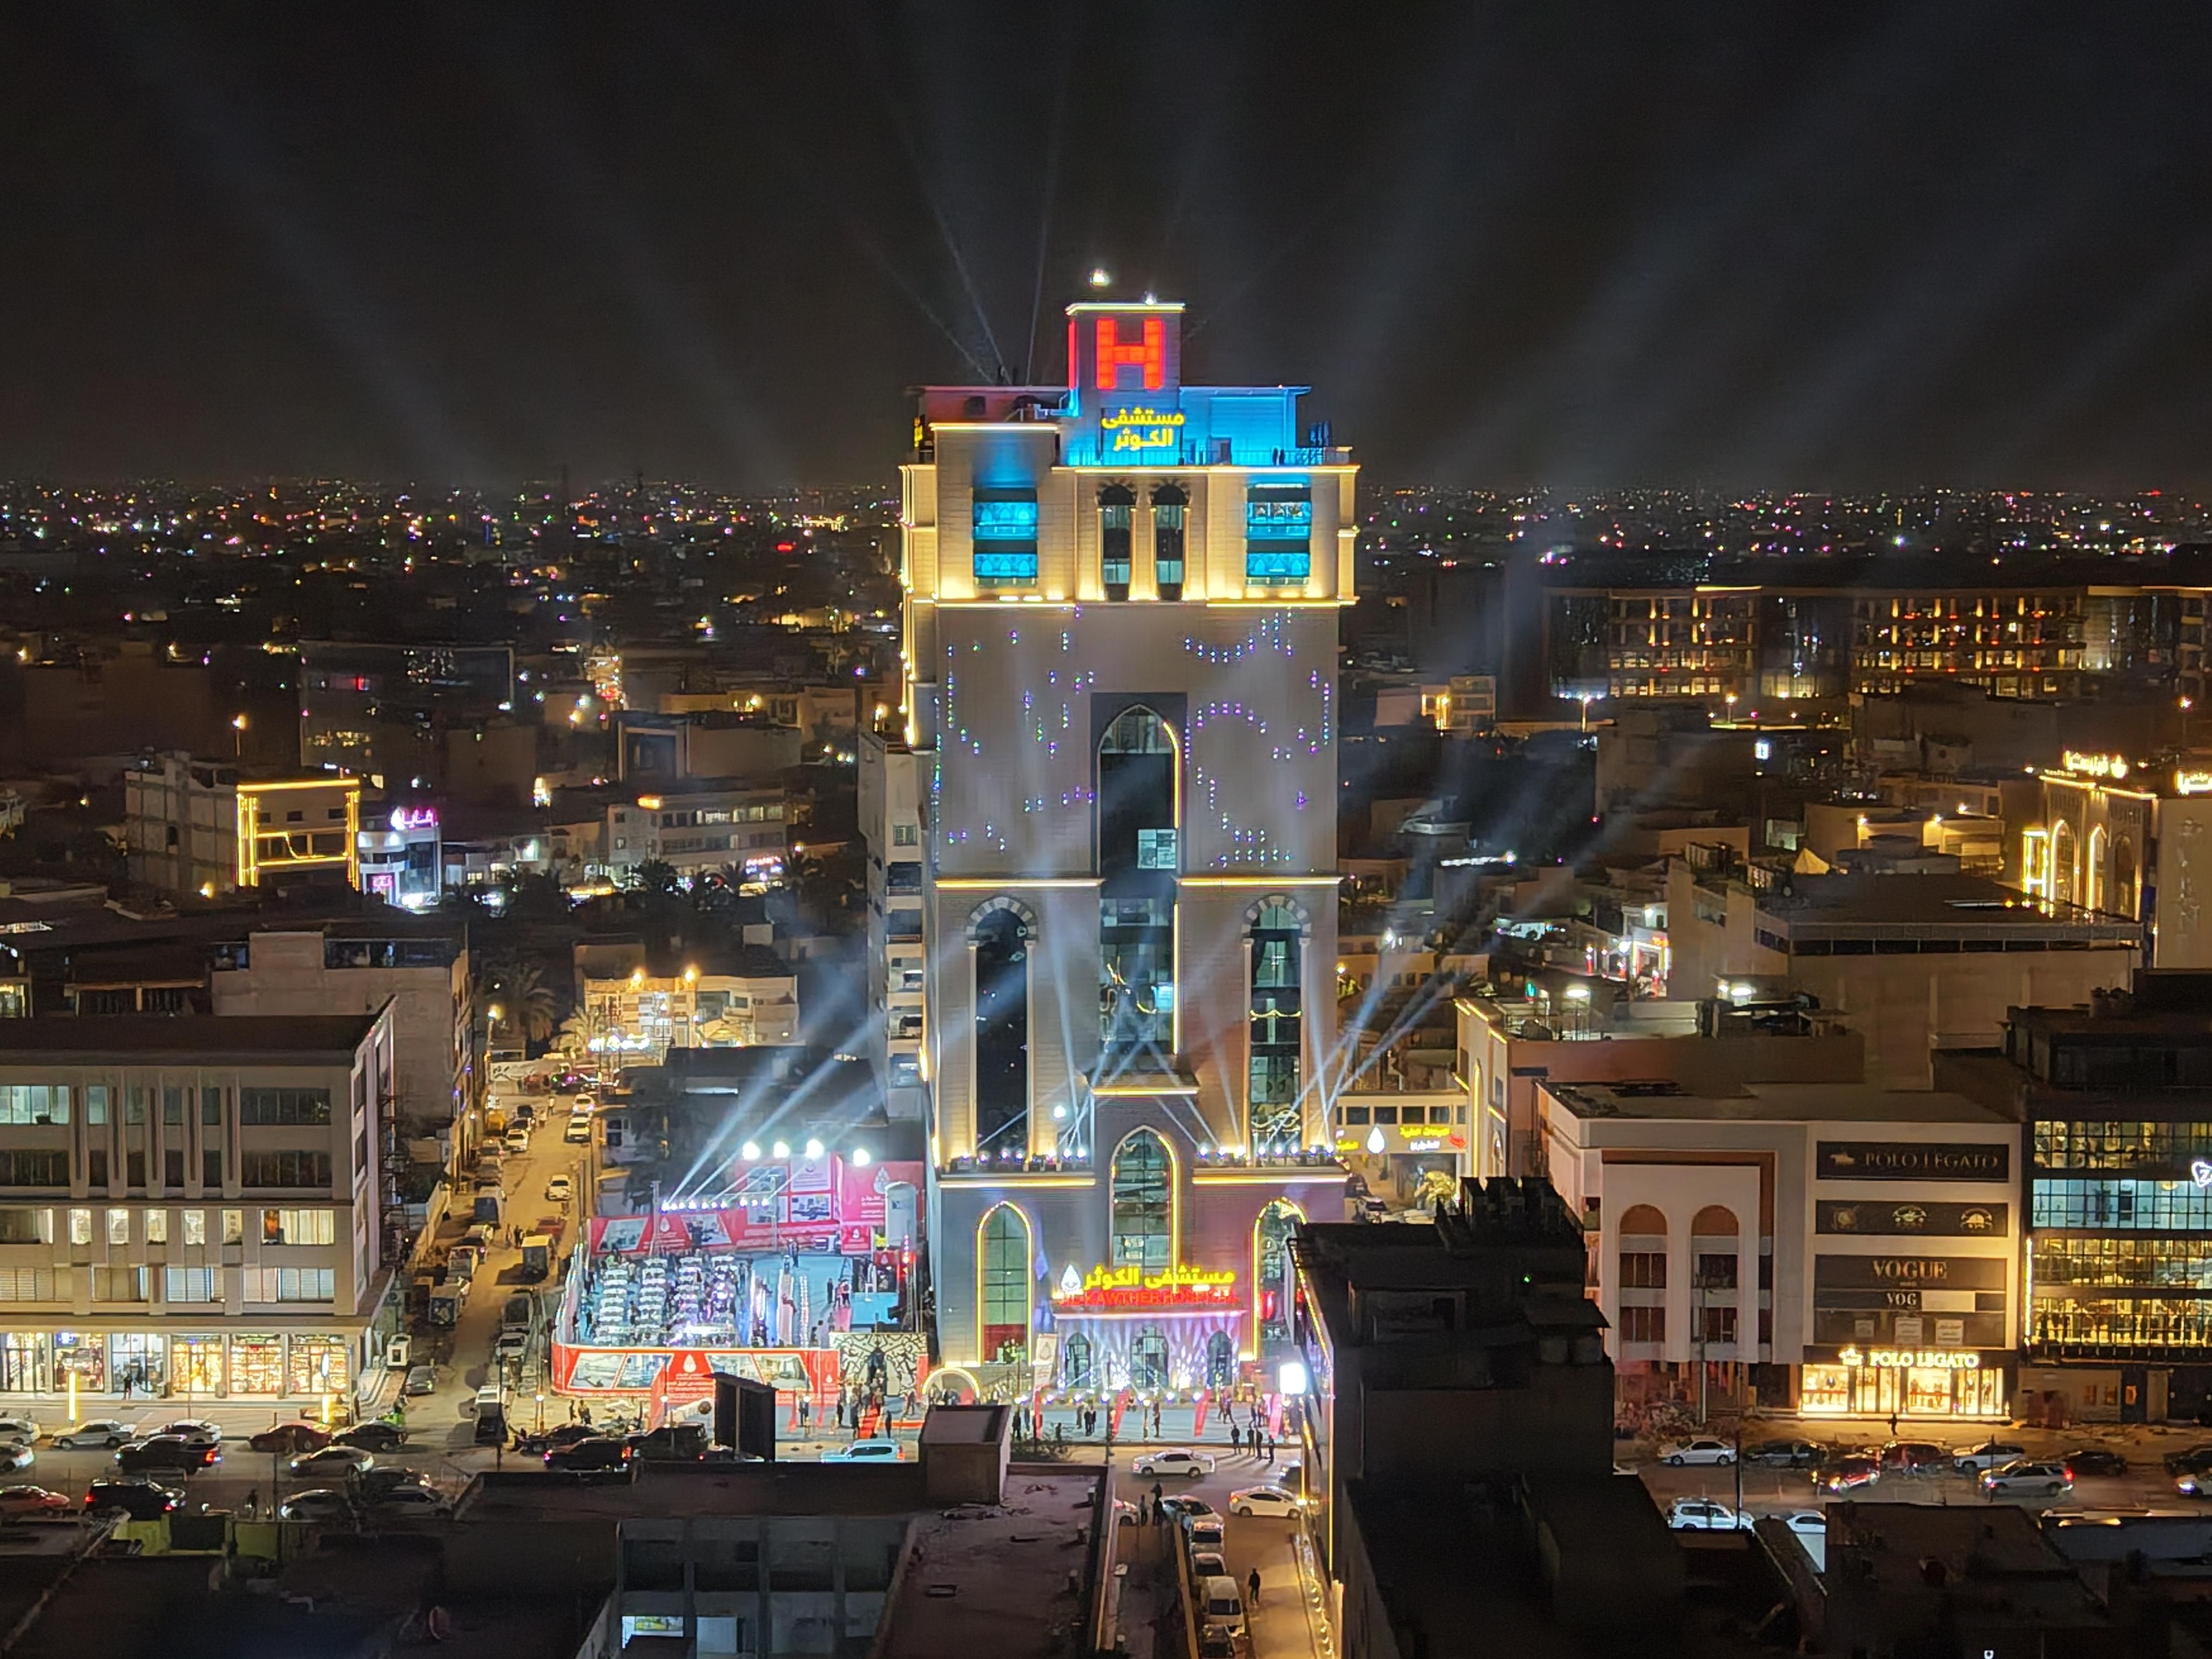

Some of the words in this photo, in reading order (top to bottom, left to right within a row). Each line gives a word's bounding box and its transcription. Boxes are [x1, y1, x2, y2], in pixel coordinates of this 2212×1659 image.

[1097, 319, 1164, 390] H
[1102, 408, 1184, 428] مستشفى
[1114, 428, 1172, 450] الكوثر
[1865, 1152, 1917, 1168] POLO
[1083, 1266, 1139, 1290] الكوثر
[1144, 1265, 1235, 1288] مستشفى
[1873, 1260, 1947, 1279] VOGUE
[1870, 1352, 1913, 1366] POLO
[1917, 1353, 1979, 1368] LEGATO
